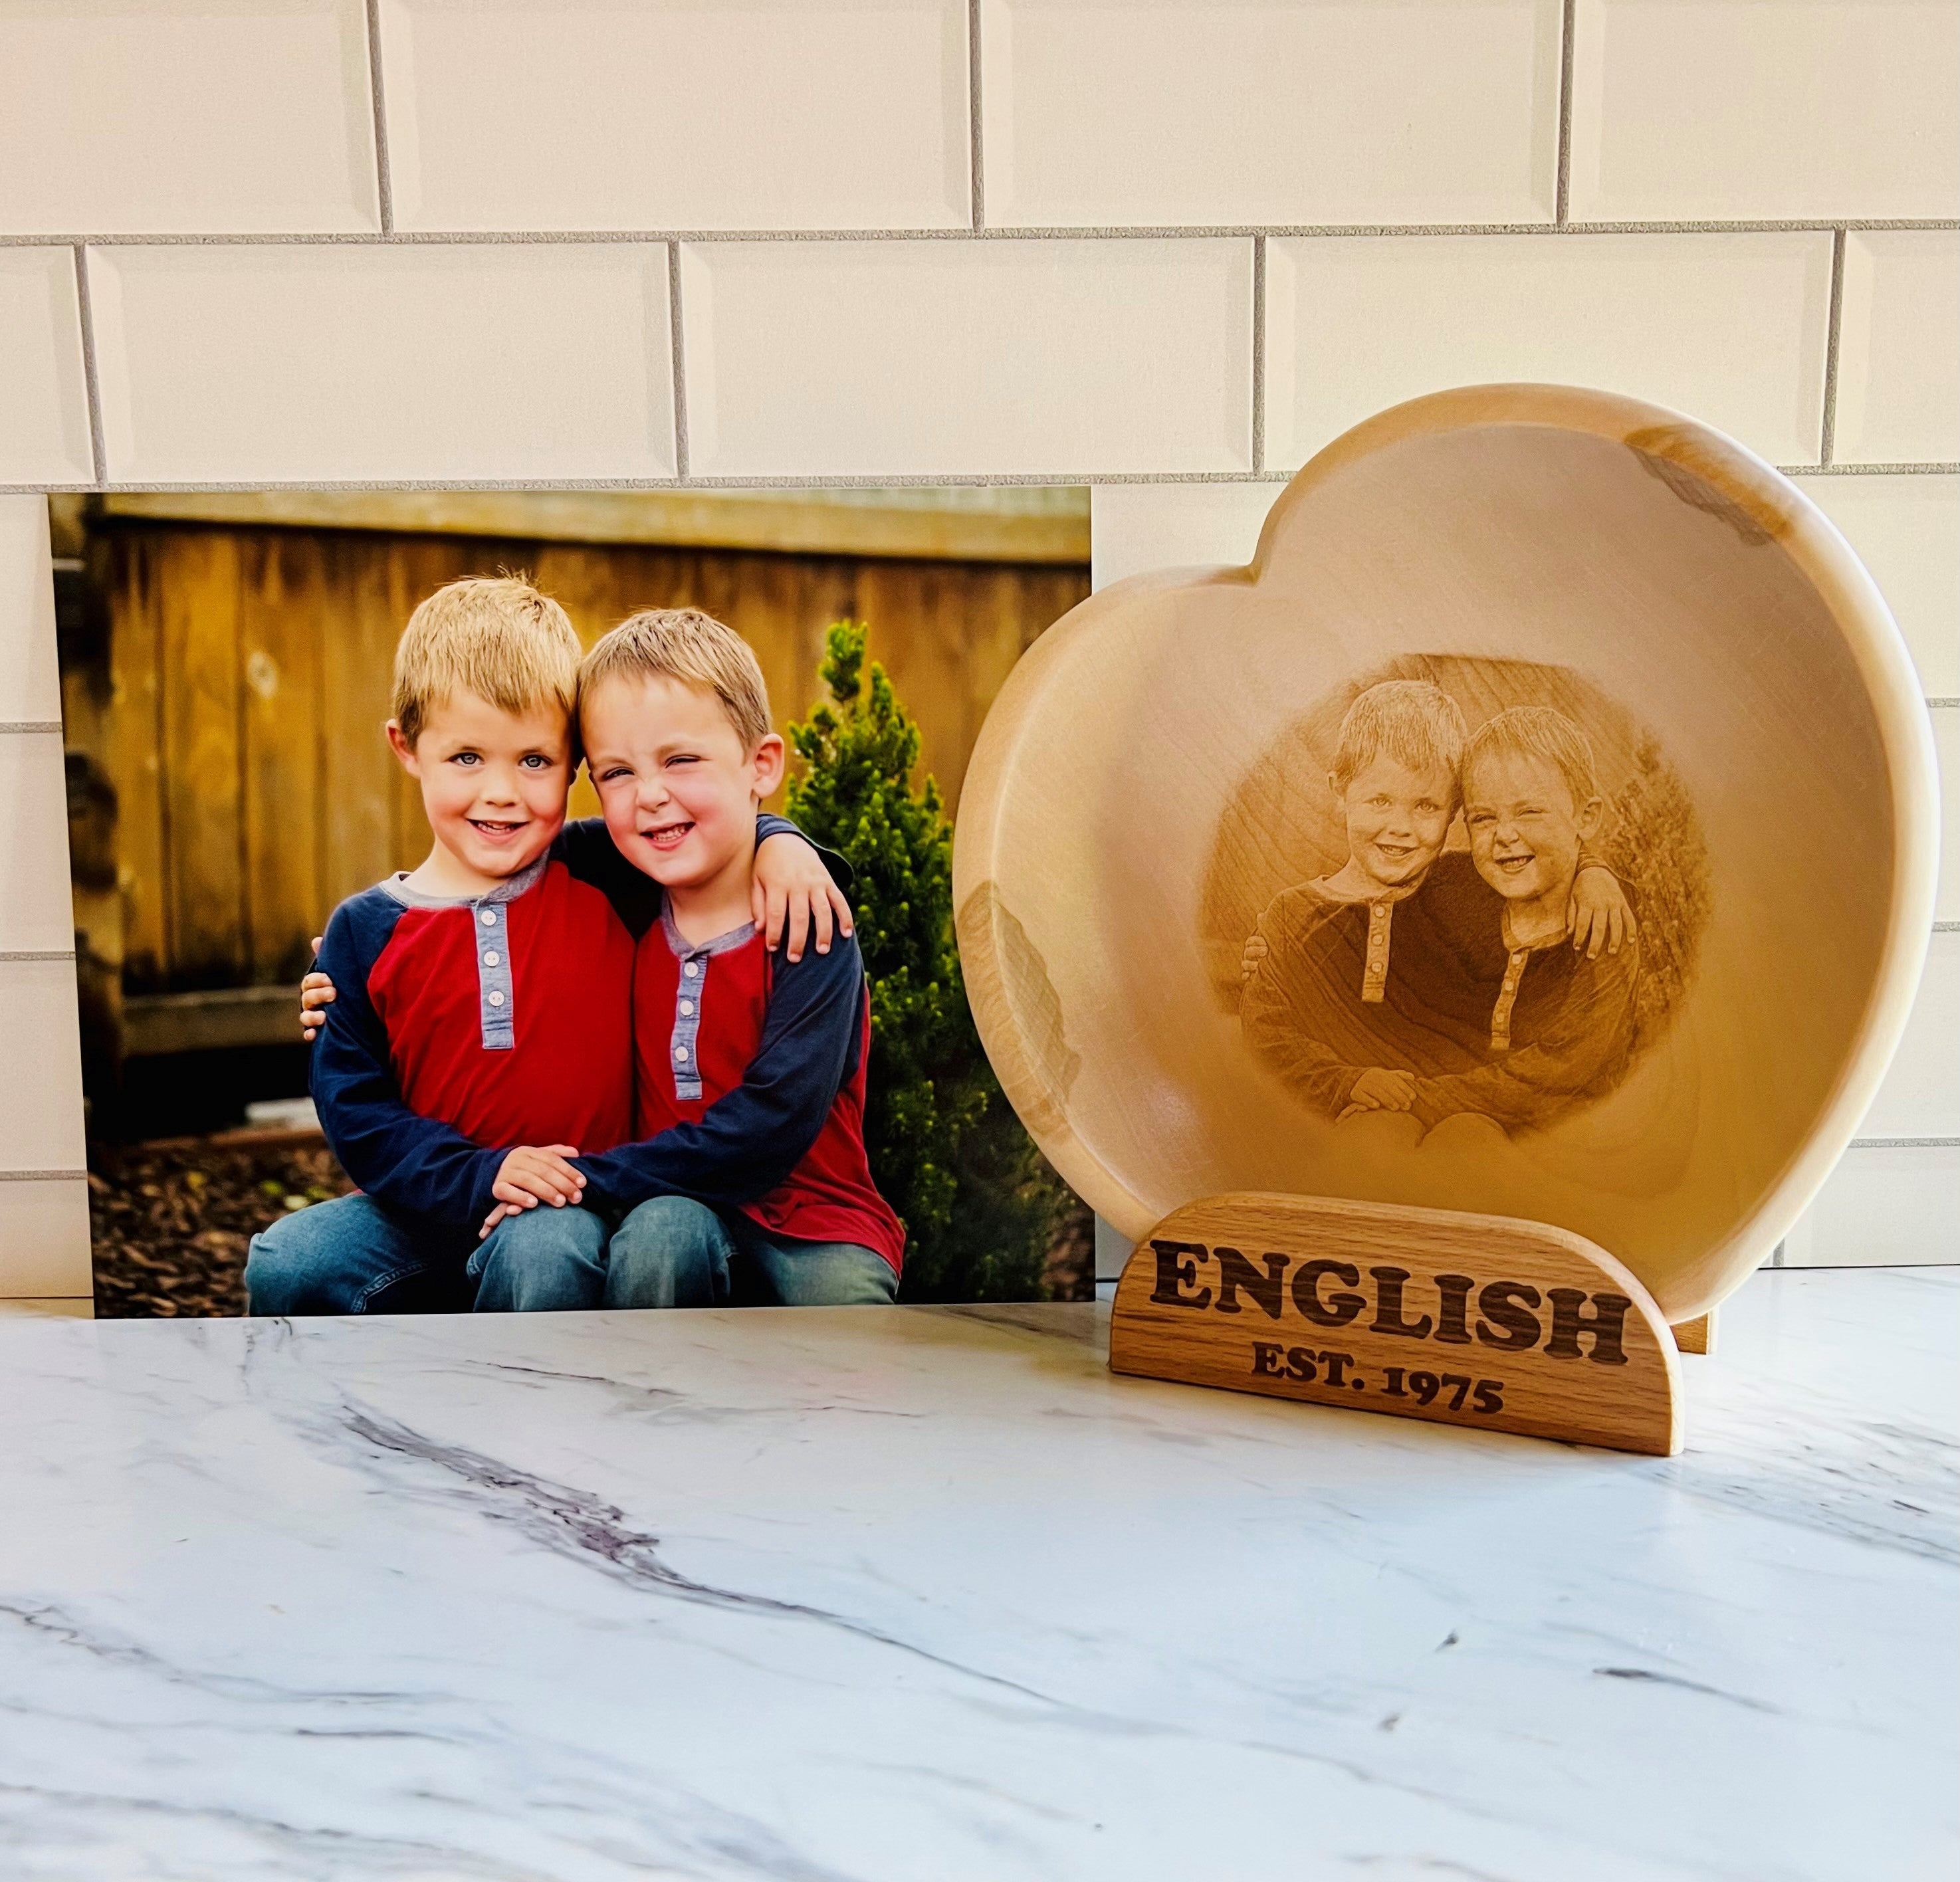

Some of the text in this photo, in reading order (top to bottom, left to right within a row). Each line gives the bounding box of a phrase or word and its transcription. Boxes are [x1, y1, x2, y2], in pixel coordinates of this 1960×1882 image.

[1149, 1239, 1632, 1366] ENGLISH
[1251, 1341, 1504, 1414] EST. 1975
